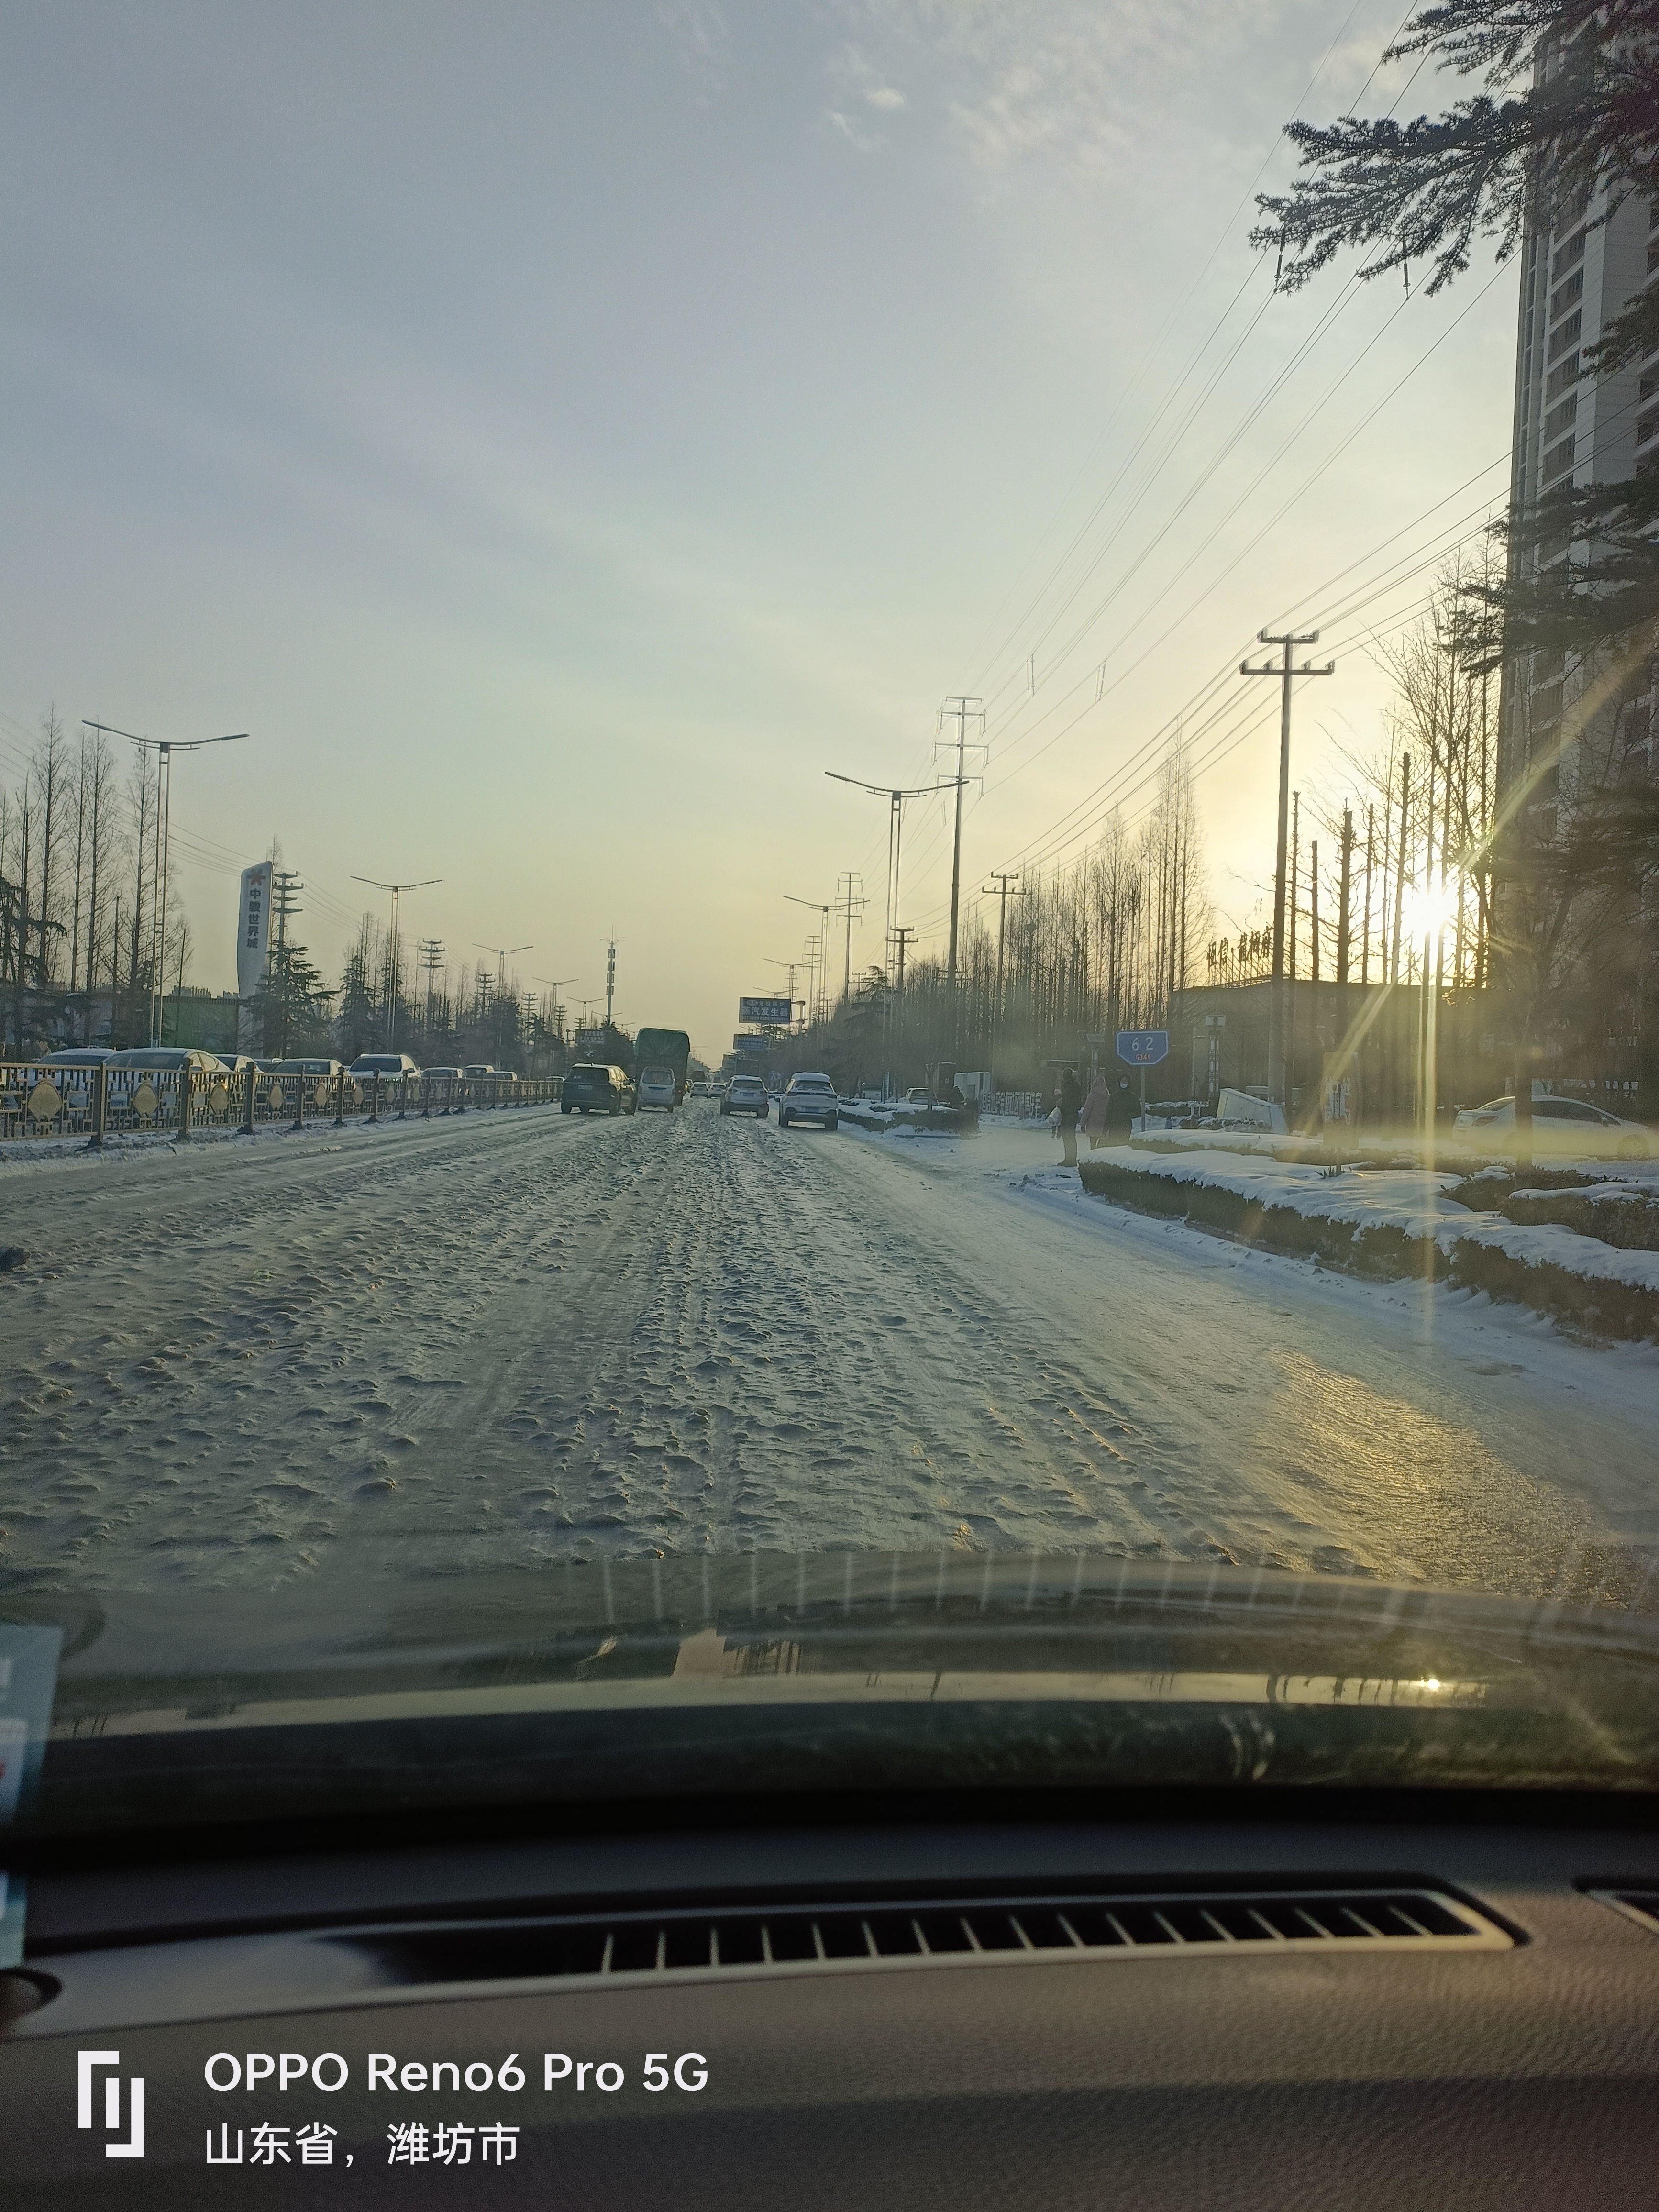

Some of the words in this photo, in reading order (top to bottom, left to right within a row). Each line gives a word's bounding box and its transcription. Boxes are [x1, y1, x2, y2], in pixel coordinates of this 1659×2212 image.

[742, 1006, 788, 1017] 蒸汽发生器
